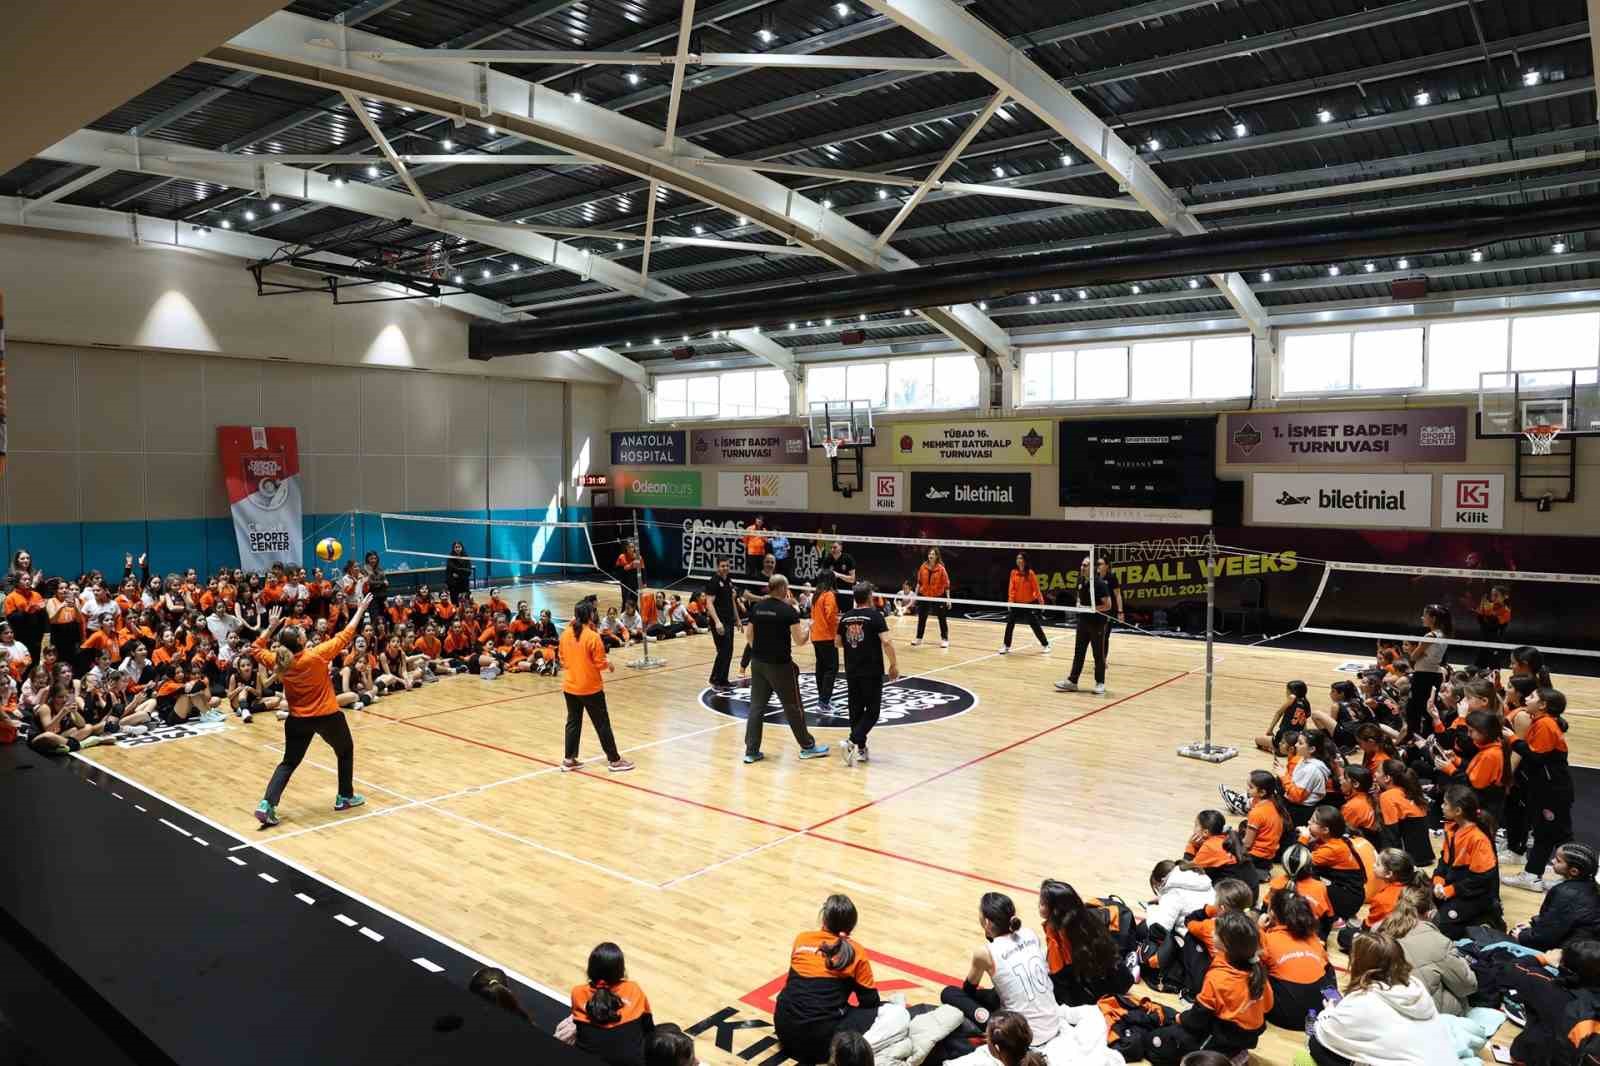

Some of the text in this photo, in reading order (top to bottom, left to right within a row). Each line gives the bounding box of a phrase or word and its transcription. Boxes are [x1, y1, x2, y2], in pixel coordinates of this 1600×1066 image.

[944, 429, 989, 439] TÜBAD 16.
[1272, 423, 1408, 438] 1. İSMET BADEM
[620, 436, 674, 447] ANATOLIA
[748, 437, 780, 446] BADEM
[922, 439, 1012, 449] MEHMET BATURALP
[1289, 440, 1390, 454] TURNUVASI
[620, 450, 675, 463] HOSPITAL
[722, 449, 771, 458] TURNUVASI
[940, 450, 992, 459] TURNUVASI
[955, 484, 1013, 503] biletinial
[1319, 489, 1406, 510] biletinial
[877, 499, 895, 508] Kilit
[1455, 511, 1488, 523] Kilit
[250, 532, 289, 542] SPORTS
[250, 541, 289, 552] CENTER
[683, 535, 745, 554] SPORTS
[794, 544, 825, 559] PLAY
[683, 551, 745, 571] CENER
[796, 556, 819, 569] THE
[1198, 550, 1297, 578] WEEKS
[1137, 585, 1176, 599] EYLÜL
[1012, 955, 1049, 1002] 10
